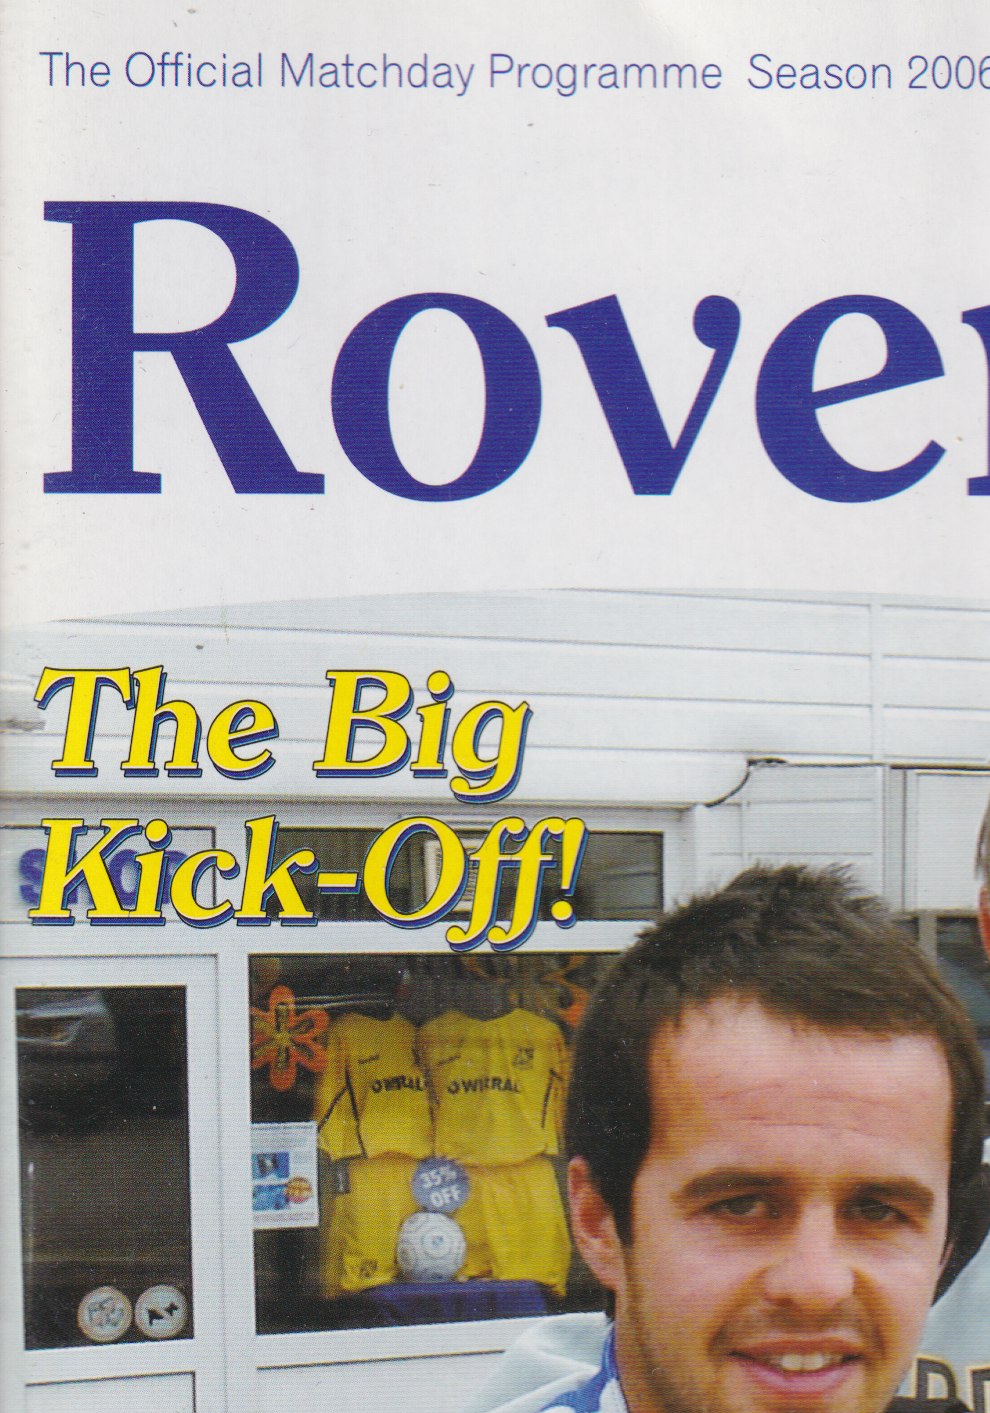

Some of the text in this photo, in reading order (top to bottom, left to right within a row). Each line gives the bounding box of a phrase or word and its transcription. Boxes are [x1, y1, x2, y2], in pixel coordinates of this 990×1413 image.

[39, 51, 111, 88] The
[125, 51, 263, 88] Official
[281, 52, 475, 97] Matchday
[490, 53, 722, 98] Programme
[747, 53, 892, 90] Season
[34, 665, 531, 803] The Big
[28, 814, 588, 951] Kick-Off!
[430, 1184, 462, 1208] OFF
